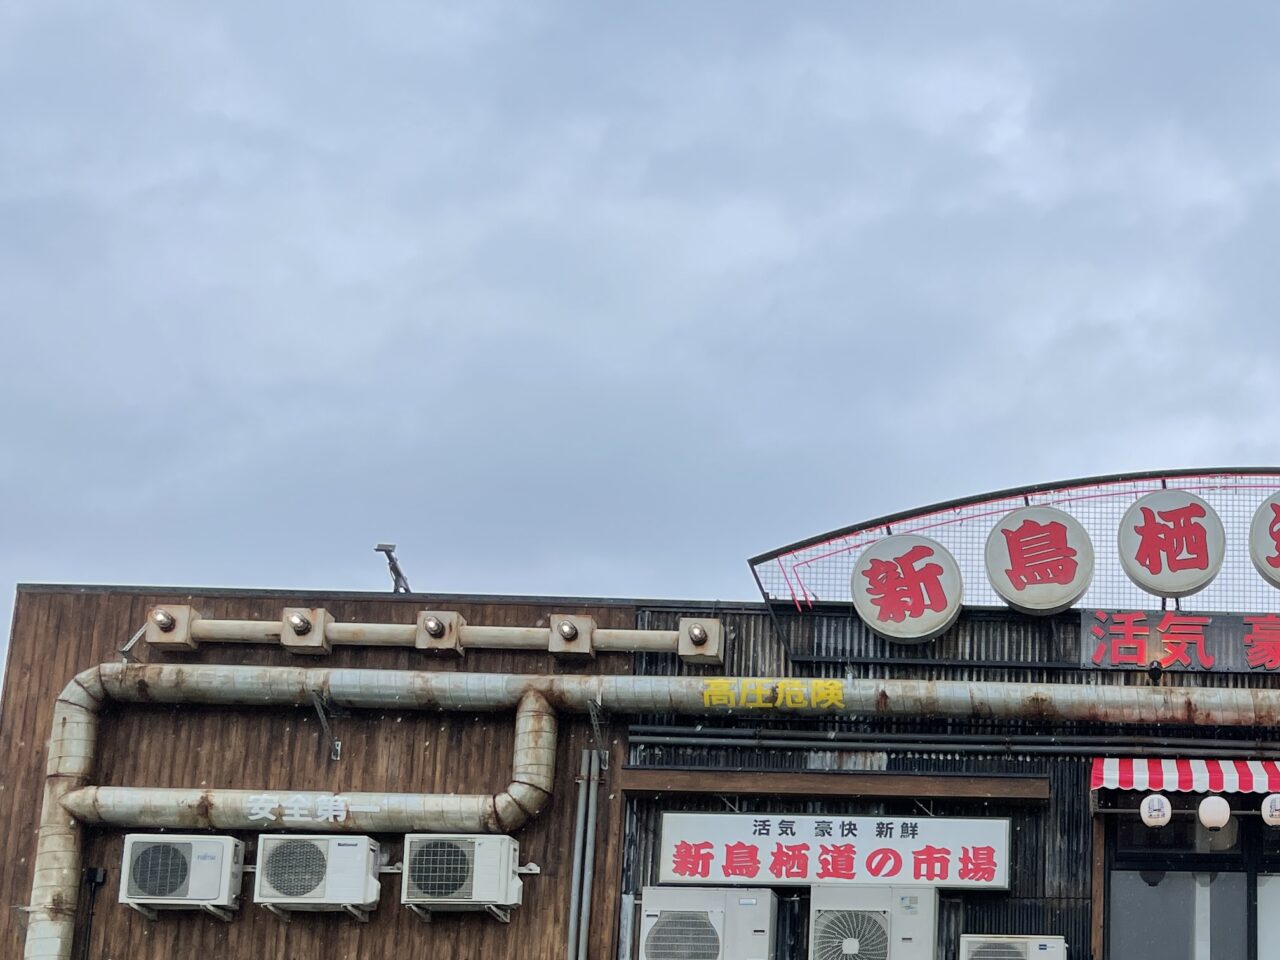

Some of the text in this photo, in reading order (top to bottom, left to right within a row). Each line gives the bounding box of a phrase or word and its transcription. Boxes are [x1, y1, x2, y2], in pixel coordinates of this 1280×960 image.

[1092, 610, 1214, 669] 活気
[701, 677, 846, 710] 高圧危険
[247, 794, 381, 823] 安全第一
[752, 819, 919, 840] 活気 豪快 新鮮
[672, 840, 998, 882] 新鳥栖道の市場
